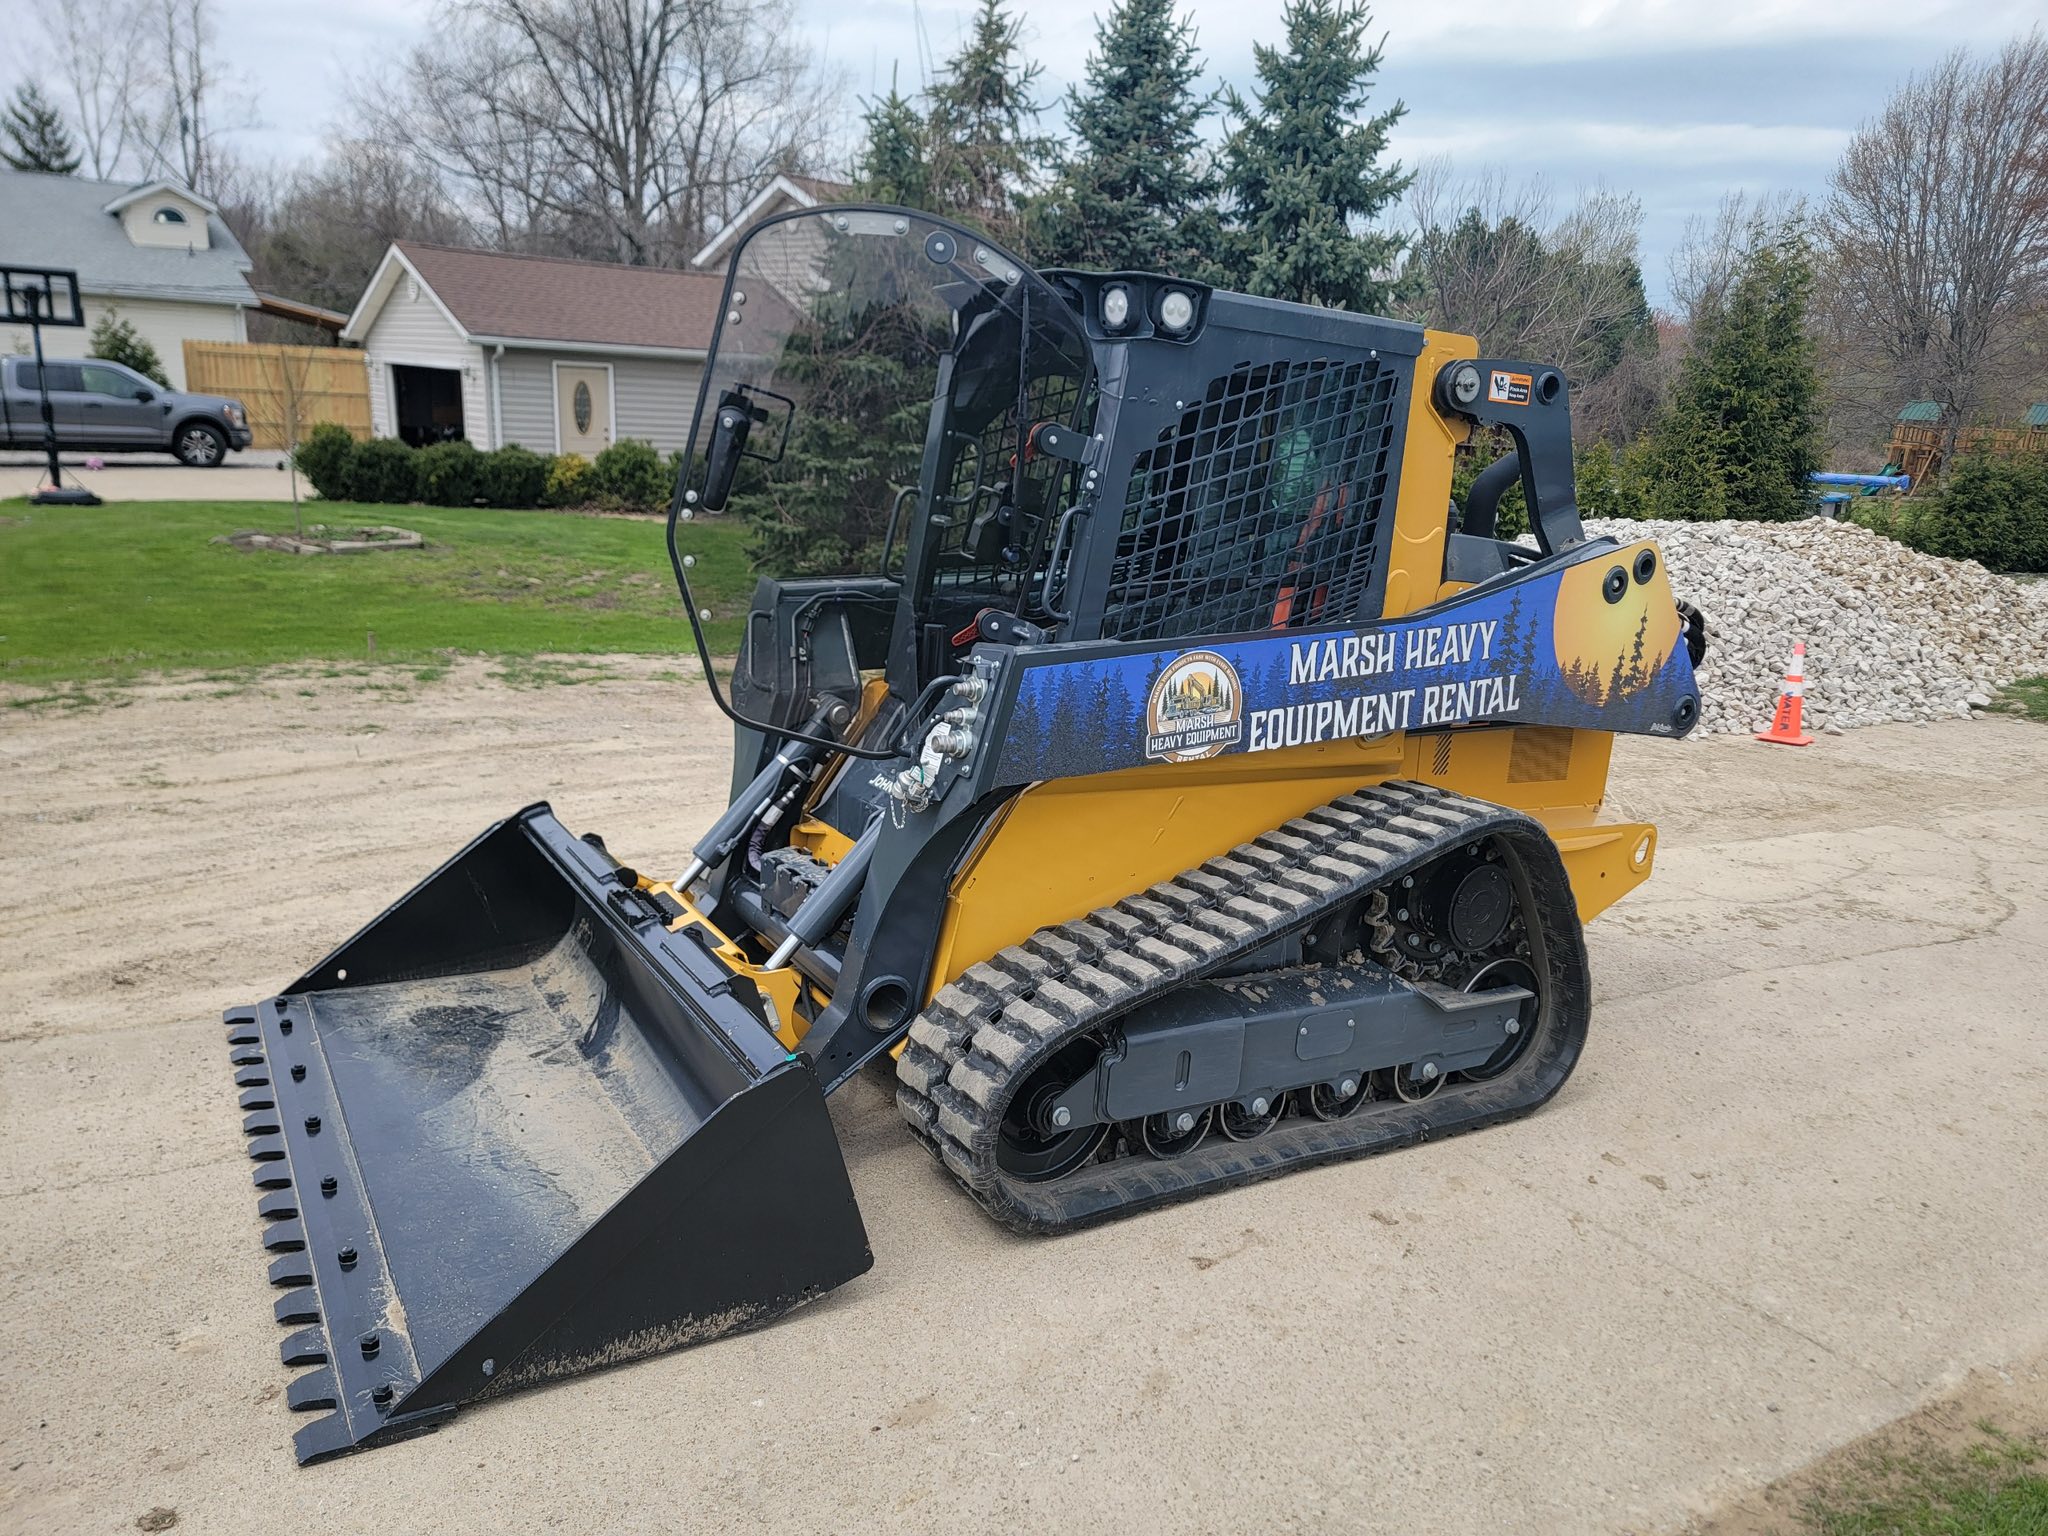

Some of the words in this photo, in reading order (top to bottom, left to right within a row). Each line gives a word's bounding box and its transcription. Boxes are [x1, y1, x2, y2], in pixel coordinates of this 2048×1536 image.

[1289, 632, 1397, 685] MARSH
[1404, 621, 1497, 669] HEAVY
[1176, 715, 1214, 732] MARSH
[1248, 689, 1415, 752] EQUIPMENT
[1422, 675, 1519, 725] RENTAL
[1780, 691, 1793, 730] WATER
[1151, 735, 1183, 751] HEAVY
[1186, 725, 1237, 746] EQUIPMENT
